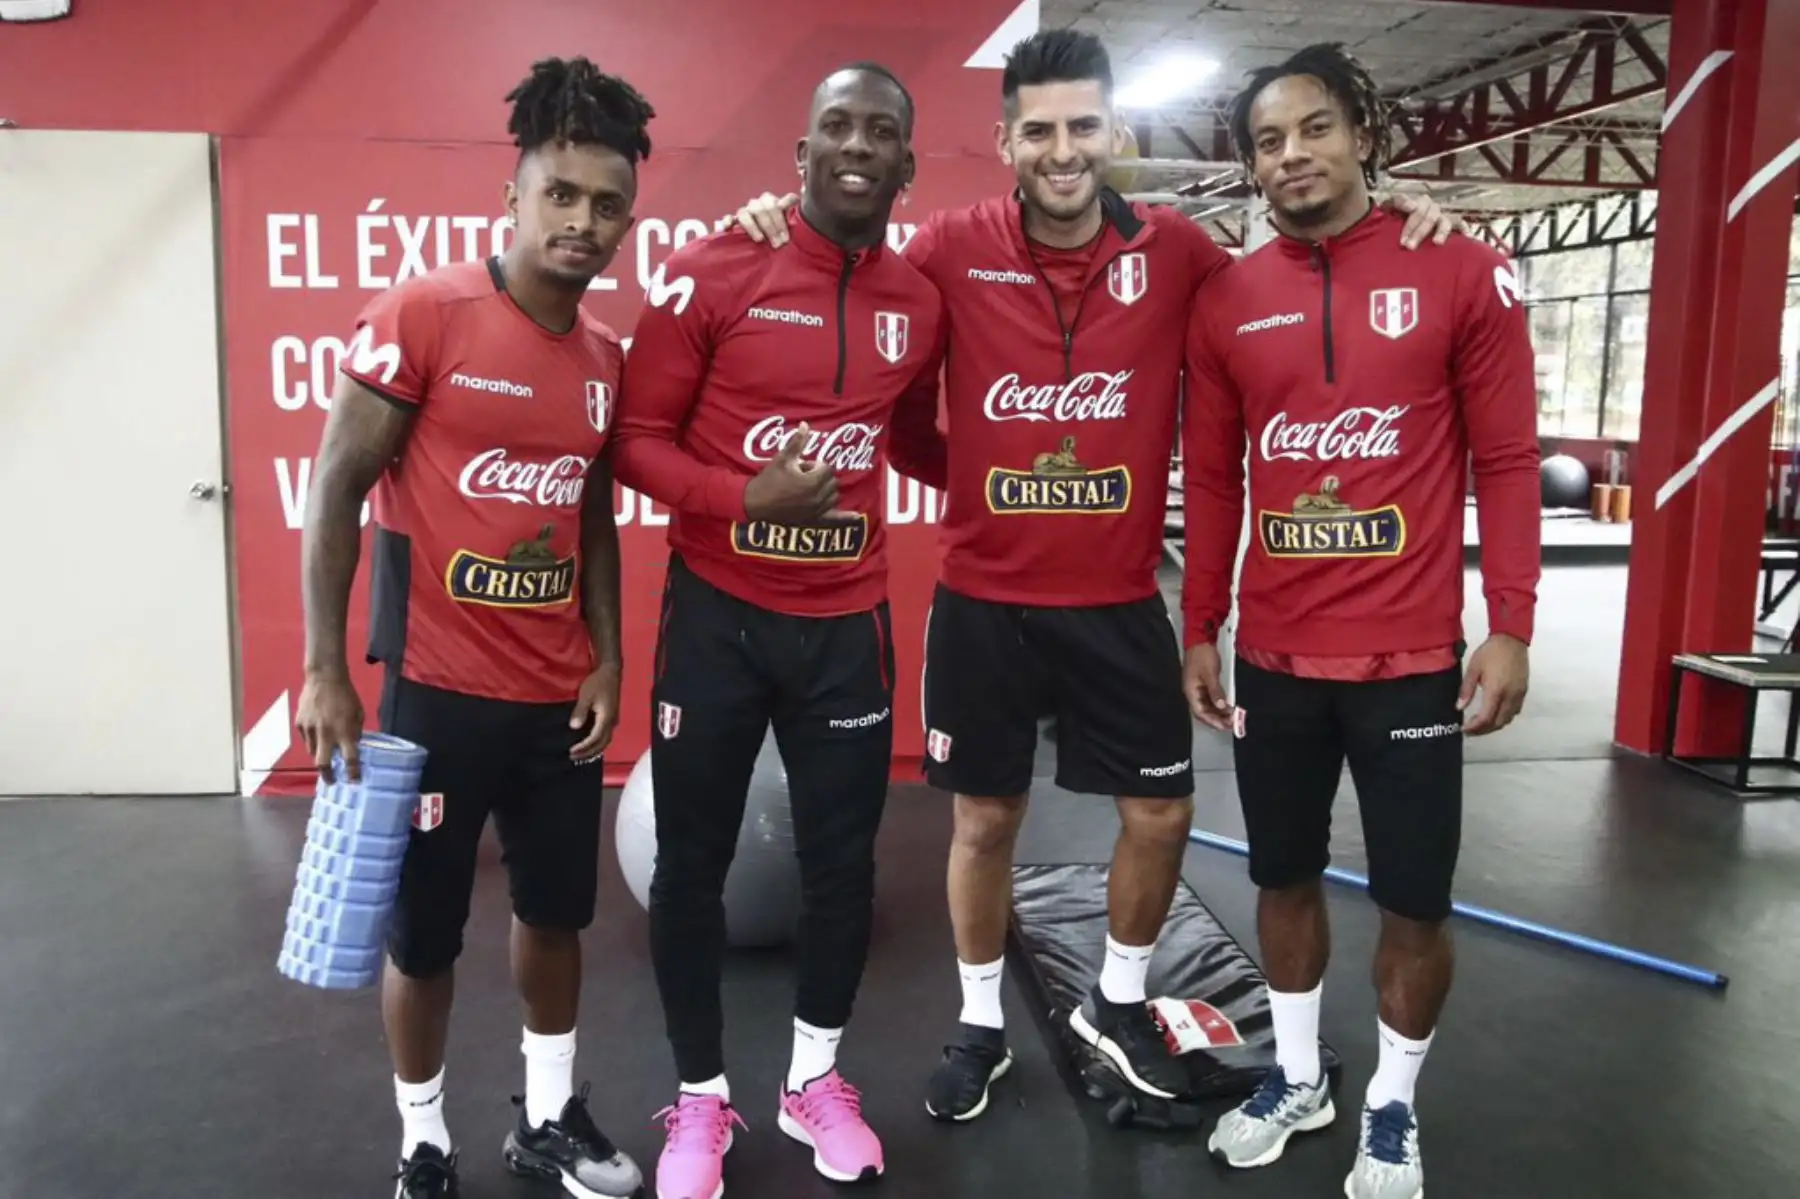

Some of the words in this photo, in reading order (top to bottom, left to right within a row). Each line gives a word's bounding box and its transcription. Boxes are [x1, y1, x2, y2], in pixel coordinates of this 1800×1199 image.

[267, 213, 339, 288] EL
[968, 267, 1037, 285] marathon
[748, 306, 823, 327] marathon
[1236, 312, 1304, 336] marathon
[451, 372, 534, 398] marathon
[984, 369, 1135, 422] Coca-Cola
[1001, 476, 1116, 505] CRISTAL
[747, 520, 856, 553] CRISTAL
[1268, 518, 1388, 550] CRISTAL
[464, 563, 570, 598] CRISTAL
[1140, 758, 1190, 778] maratho
